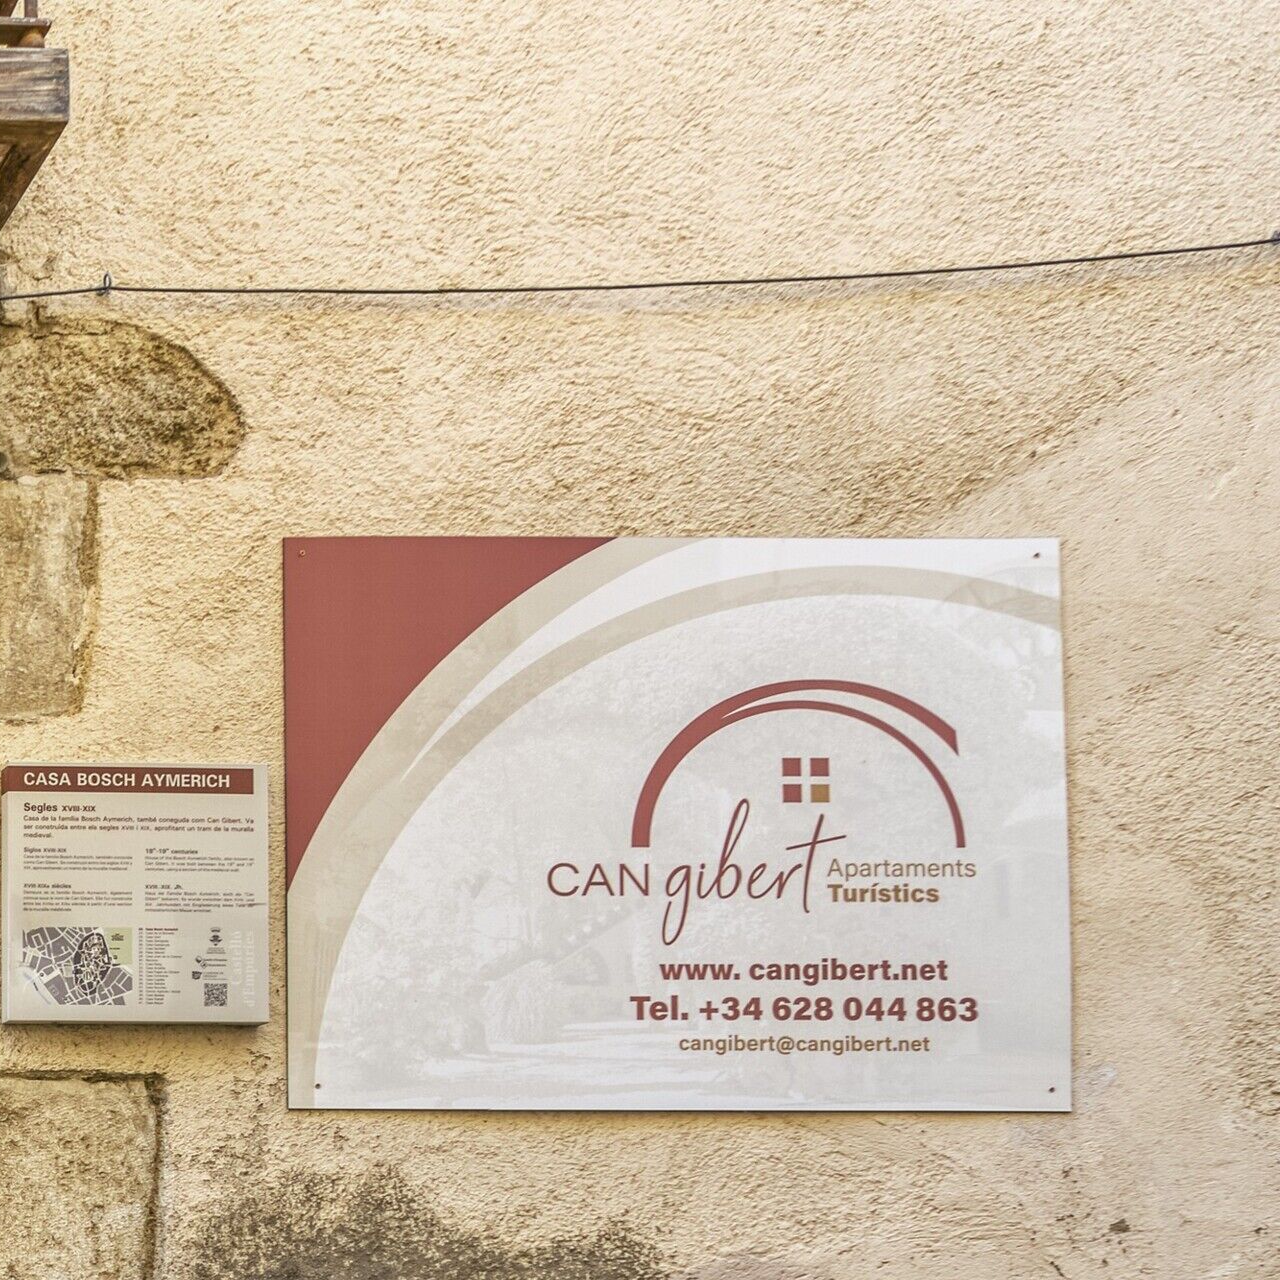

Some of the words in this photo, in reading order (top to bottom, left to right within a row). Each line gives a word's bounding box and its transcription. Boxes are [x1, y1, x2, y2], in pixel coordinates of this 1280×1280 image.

[23, 772, 71, 787] CASA
[77, 773, 136, 787] BOSCH
[141, 773, 231, 788] AYMERICH
[23, 802, 58, 814] Segles
[547, 862, 650, 897] CAN
[661, 798, 847, 946] gibert
[827, 857, 977, 881] Apartaments
[827, 883, 940, 903] Turístics
[659, 961, 740, 981] www.
[749, 958, 948, 986] cangibert.net
[630, 995, 689, 1020] Tel.
[699, 997, 763, 1021] +34
[772, 997, 833, 1021] 628
[843, 997, 907, 1021] 044
[916, 997, 979, 1022] 863
[679, 1034, 930, 1056] cangibert@cangibert.net
